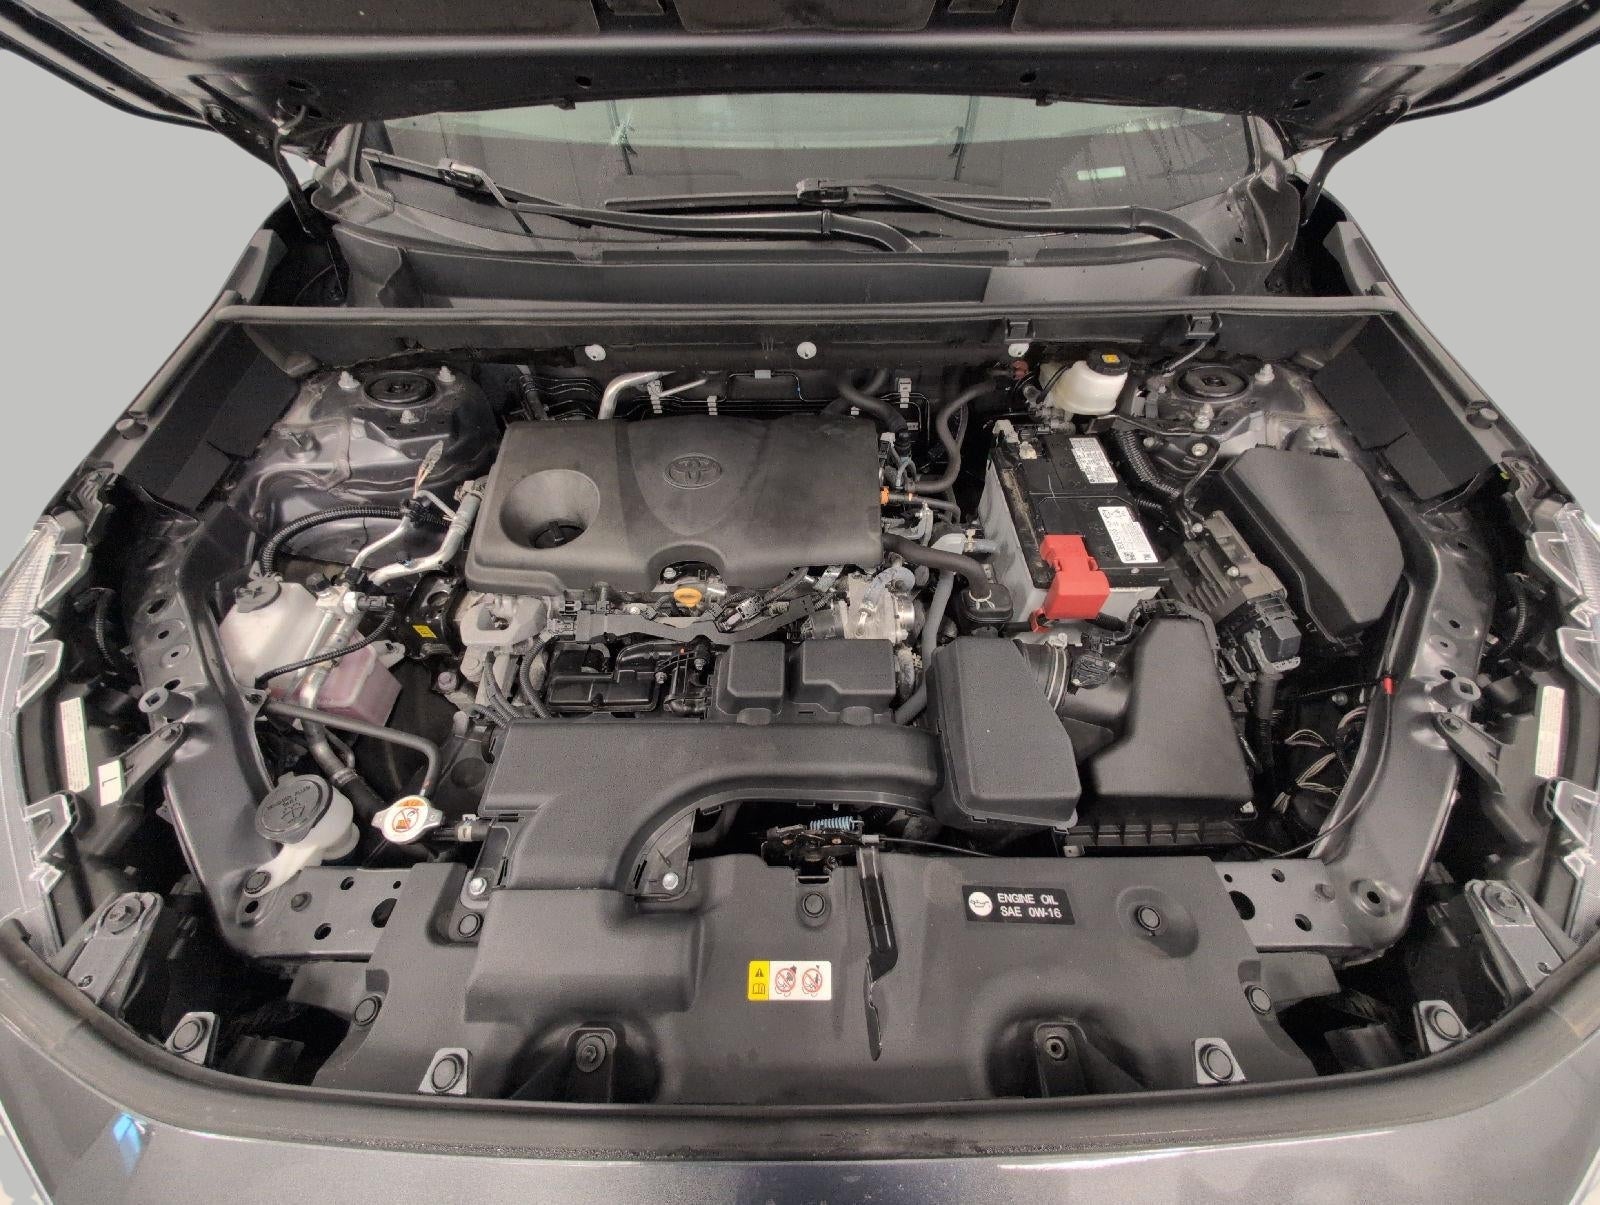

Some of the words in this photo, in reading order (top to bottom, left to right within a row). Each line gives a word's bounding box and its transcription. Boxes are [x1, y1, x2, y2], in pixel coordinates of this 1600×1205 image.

[997, 893, 1035, 904] ENGINE
[1040, 894, 1058, 905] OIL
[1000, 906, 1022, 917] SAE
[1028, 907, 1062, 918] 0W-16
